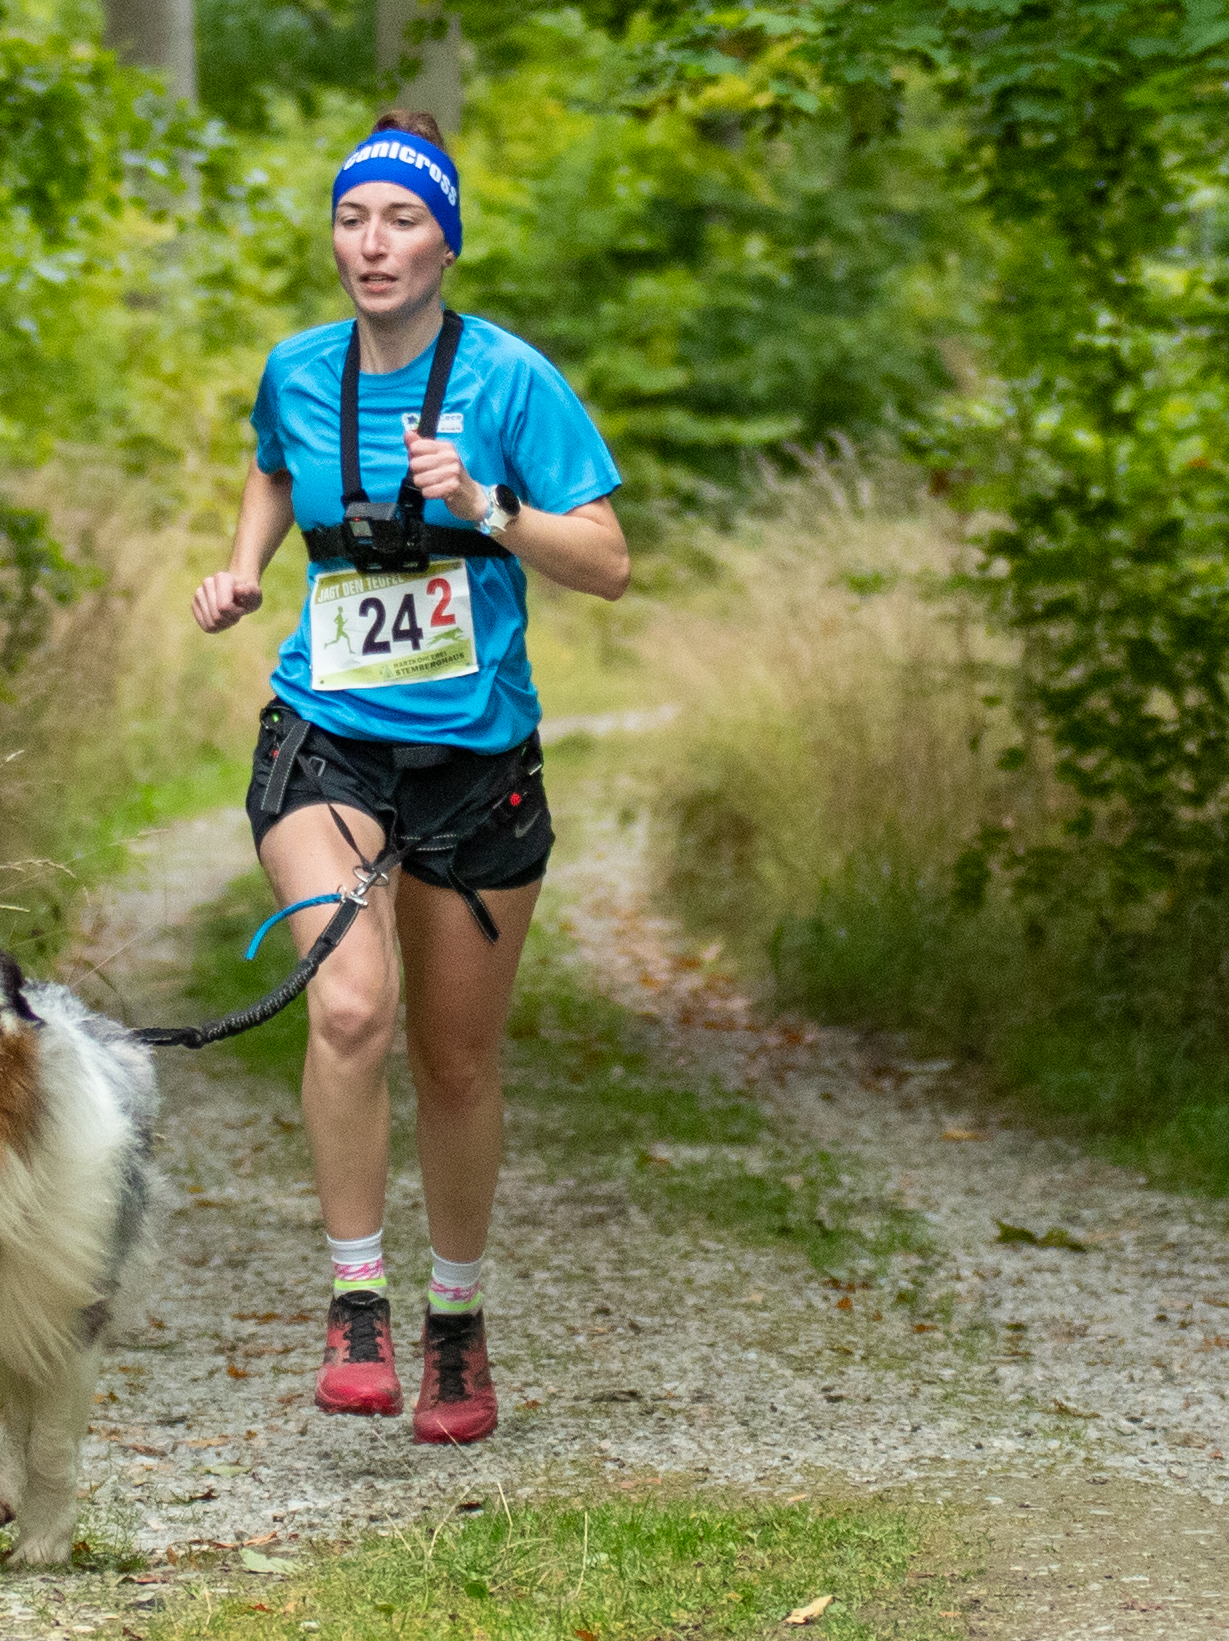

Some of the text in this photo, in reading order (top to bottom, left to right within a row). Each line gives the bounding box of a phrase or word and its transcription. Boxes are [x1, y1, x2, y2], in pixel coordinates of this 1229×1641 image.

[318, 585, 340, 602] JAGT
[342, 578, 364, 596] DEN
[426, 577, 456, 627] 2
[359, 594, 423, 655] 24
